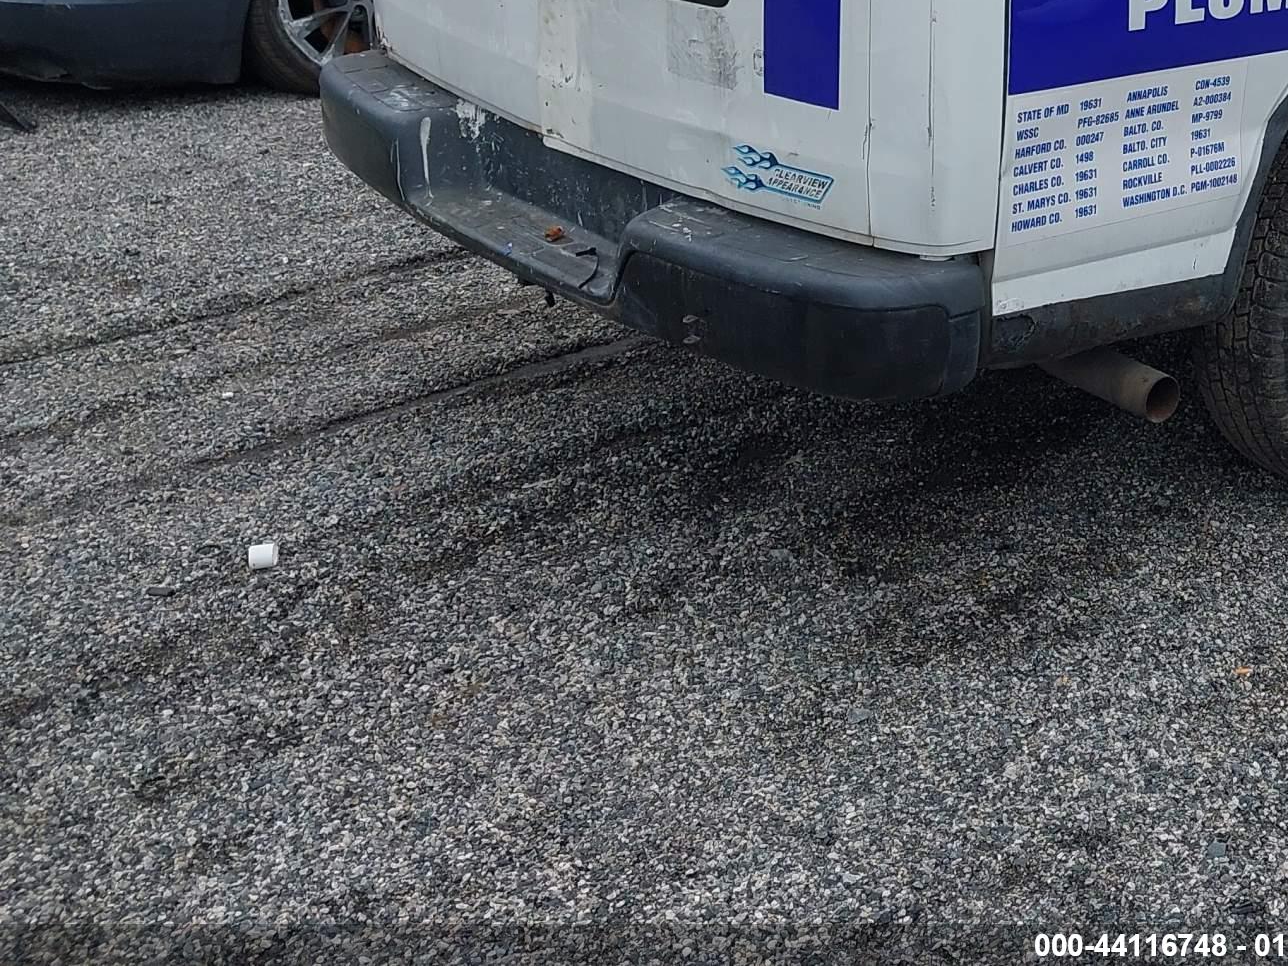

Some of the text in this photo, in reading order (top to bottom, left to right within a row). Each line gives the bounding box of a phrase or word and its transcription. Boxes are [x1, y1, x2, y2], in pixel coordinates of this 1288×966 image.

[1127, 76, 1230, 103] ANNAPOLIS CON-4539
[1017, 98, 1102, 123] STATE OF MD 19631
[1125, 106, 1145, 120] ANNE
[1146, 100, 1179, 115] ARUNDEL
[1016, 127, 1039, 141] WSSC
[1123, 109, 1223, 137] BALTO. CO. MP-9799
[1015, 132, 1104, 159] HARFORD CO. 000247
[1123, 128, 1211, 154] BALTO. CITY 19631
[1013, 160, 1048, 177] CALVERT
[1050, 158, 1063, 169] CO.
[1122, 156, 1155, 172] CARROLL
[1157, 154, 1170, 165] CO.
[1013, 169, 1097, 196] CHARLES CO. 19631
[1122, 172, 1162, 190] ROCKVILLE
[1012, 187, 1097, 214] ST. MARYS CO. 19631
[1122, 188, 1170, 208] WASHINGTON
[1172, 185, 1187, 196] D.C.
[1011, 204, 1097, 232] HOWARD CO. 19631
